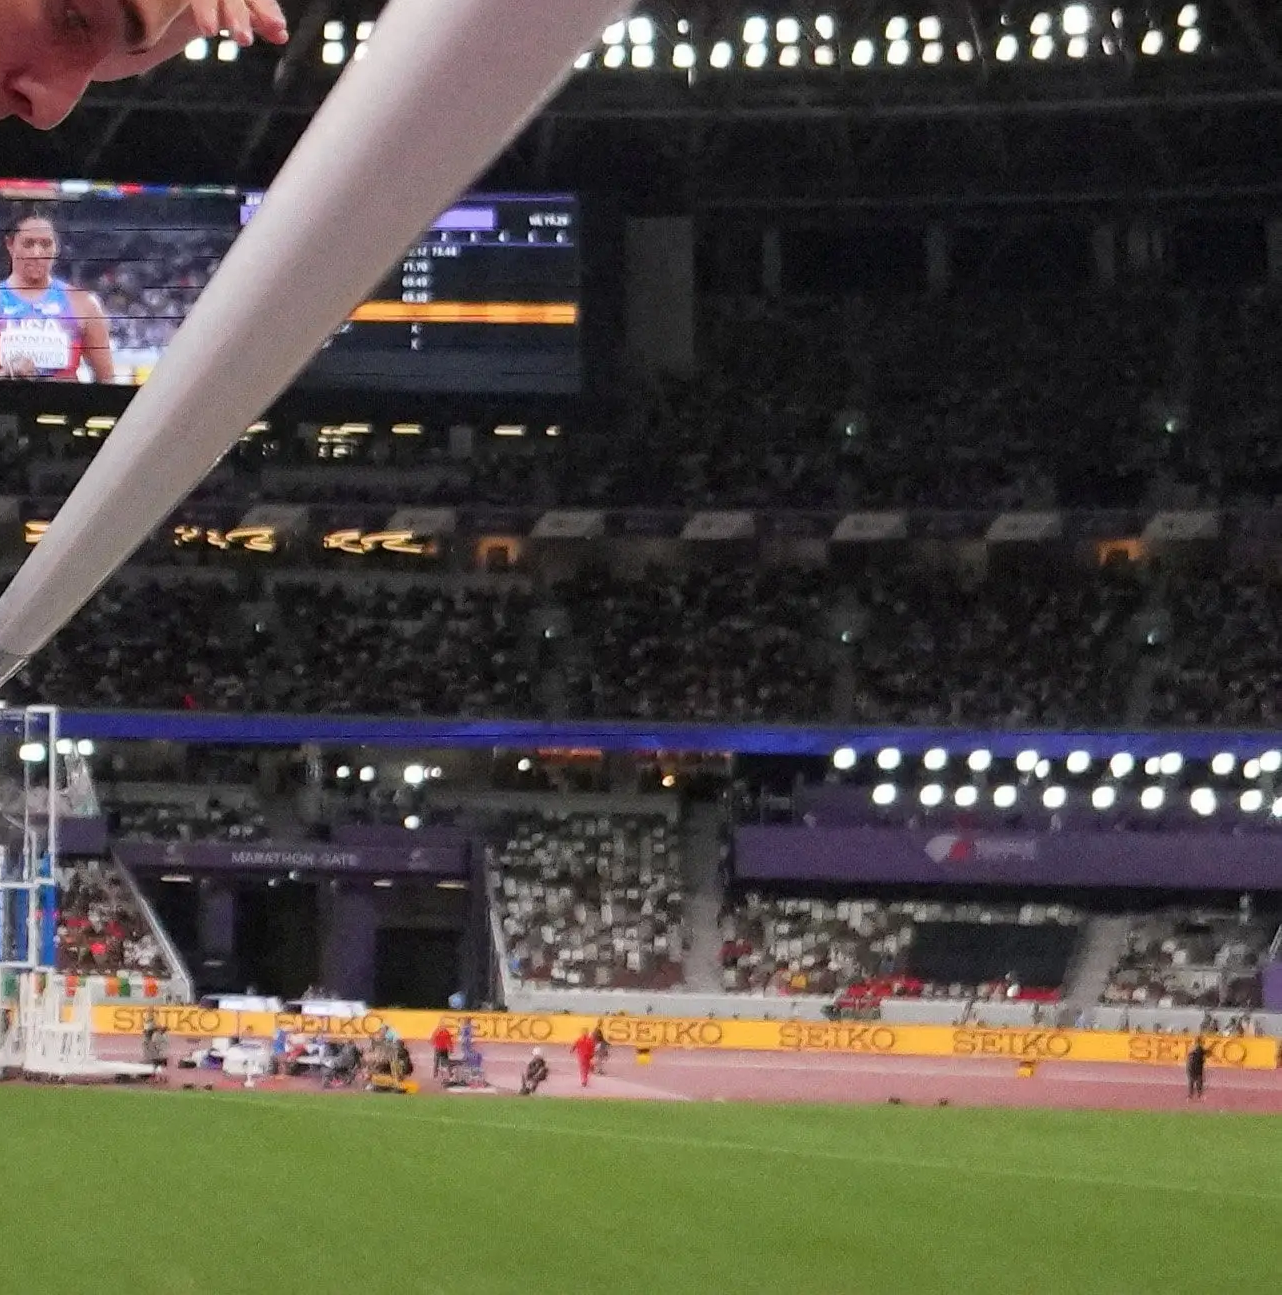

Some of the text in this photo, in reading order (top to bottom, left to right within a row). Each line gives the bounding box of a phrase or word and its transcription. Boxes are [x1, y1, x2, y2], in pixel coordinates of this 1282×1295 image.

[607, 1019, 723, 1045] SEIKO
[779, 1022, 896, 1051] SEIKO
[952, 1030, 1072, 1056] SEIKO
